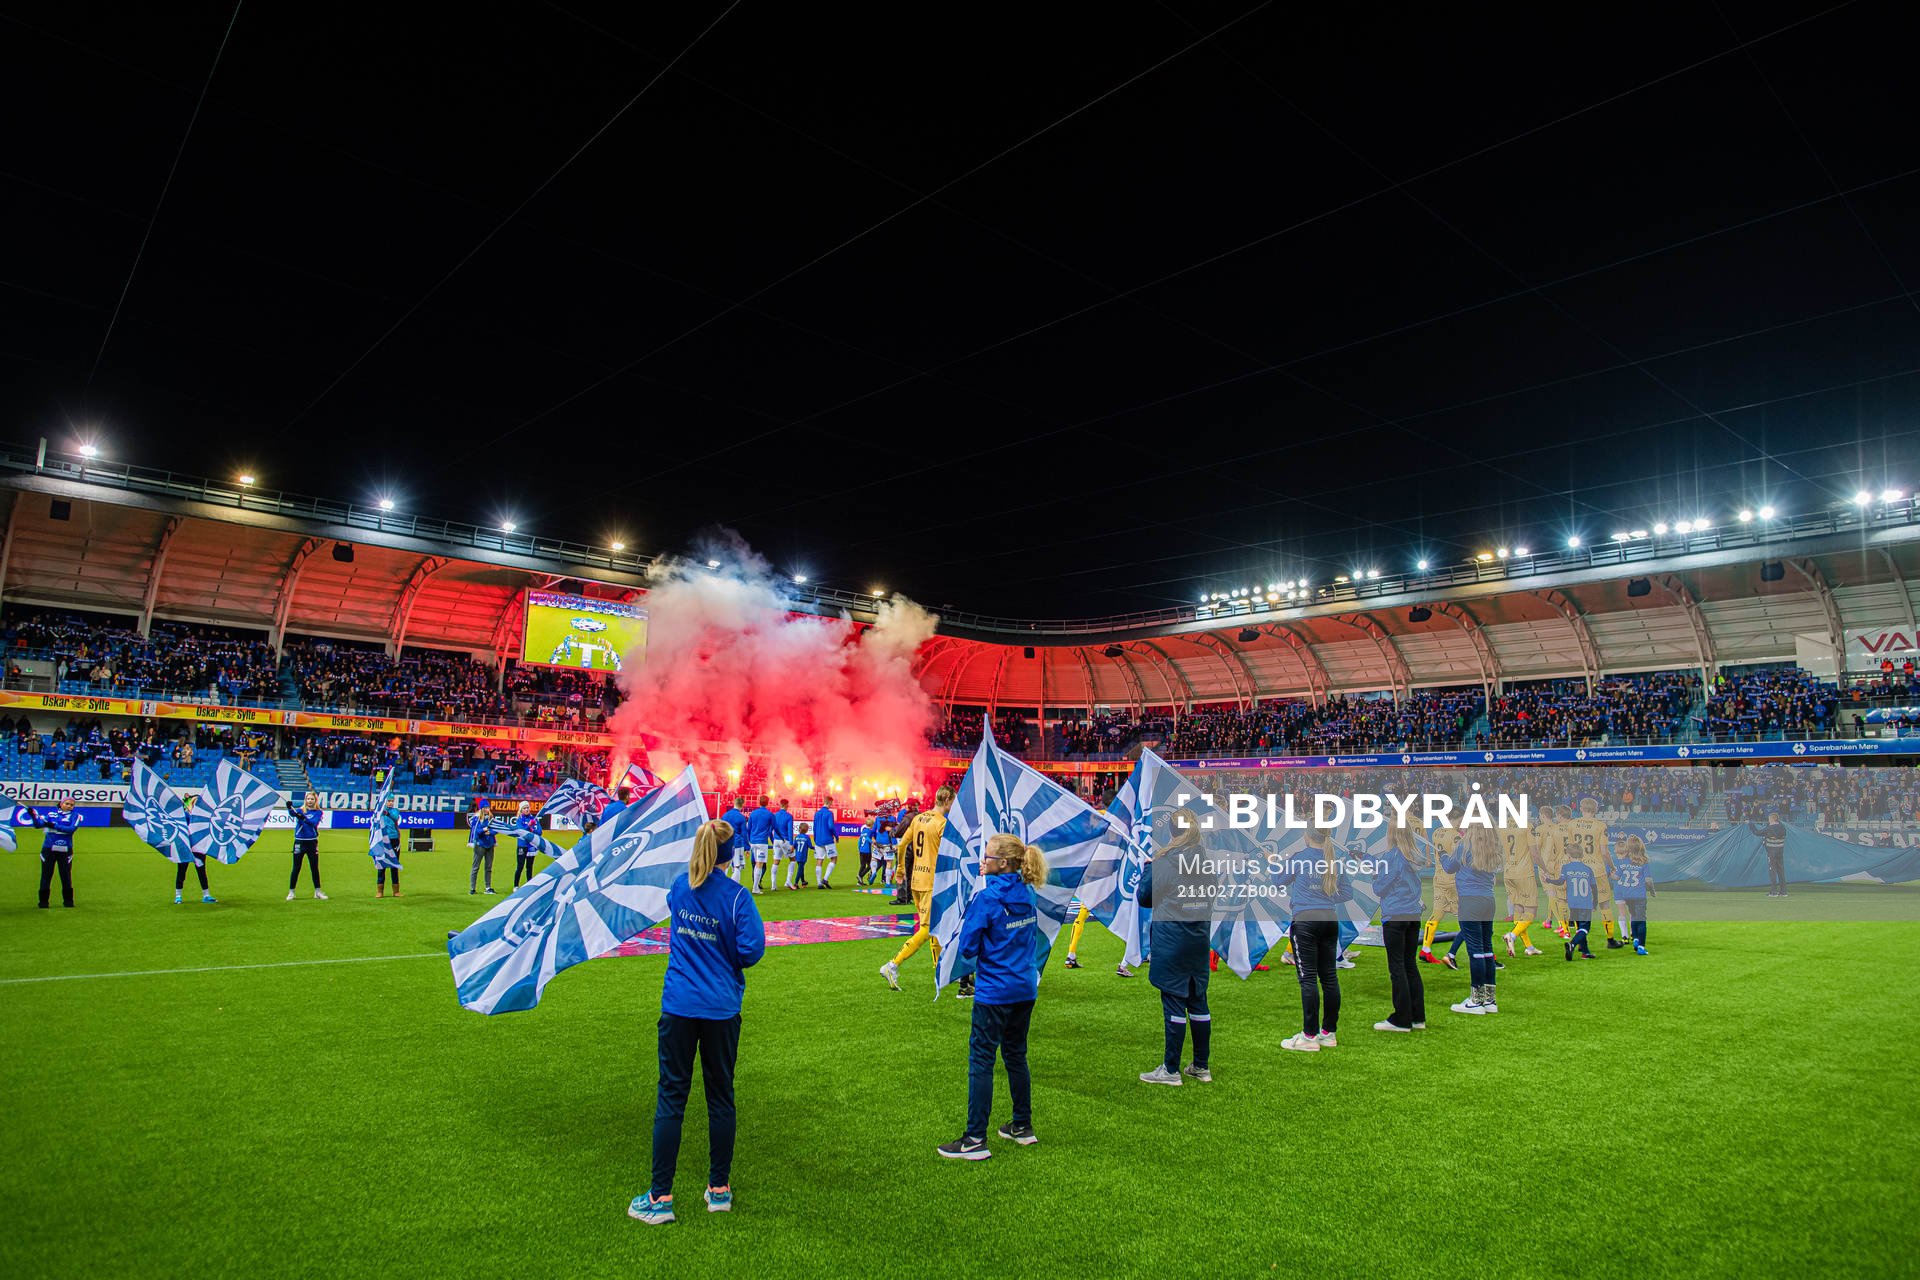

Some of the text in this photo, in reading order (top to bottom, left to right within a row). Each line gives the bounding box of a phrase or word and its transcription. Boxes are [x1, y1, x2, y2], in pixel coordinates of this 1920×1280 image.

[1858, 630, 1920, 653] VA
[42, 695, 110, 712] Oskar Sylte
[196, 706, 256, 721] Oskar Sylte
[332, 715, 384, 730] Oskar Sylte
[451, 724, 497, 737] Oskar Sylte
[1588, 750, 1626, 758] Sparebanken
[1692, 747, 1735, 755] Sparebanken
[1809, 744, 1857, 752] Sparebanken
[407, 815, 434, 825] Steen
[796, 841, 805, 853] 17
[916, 830, 925, 858] 9
[1507, 834, 1515, 856] 2
[1622, 869, 1640, 887] 23
[1570, 877, 1589, 897] 10
